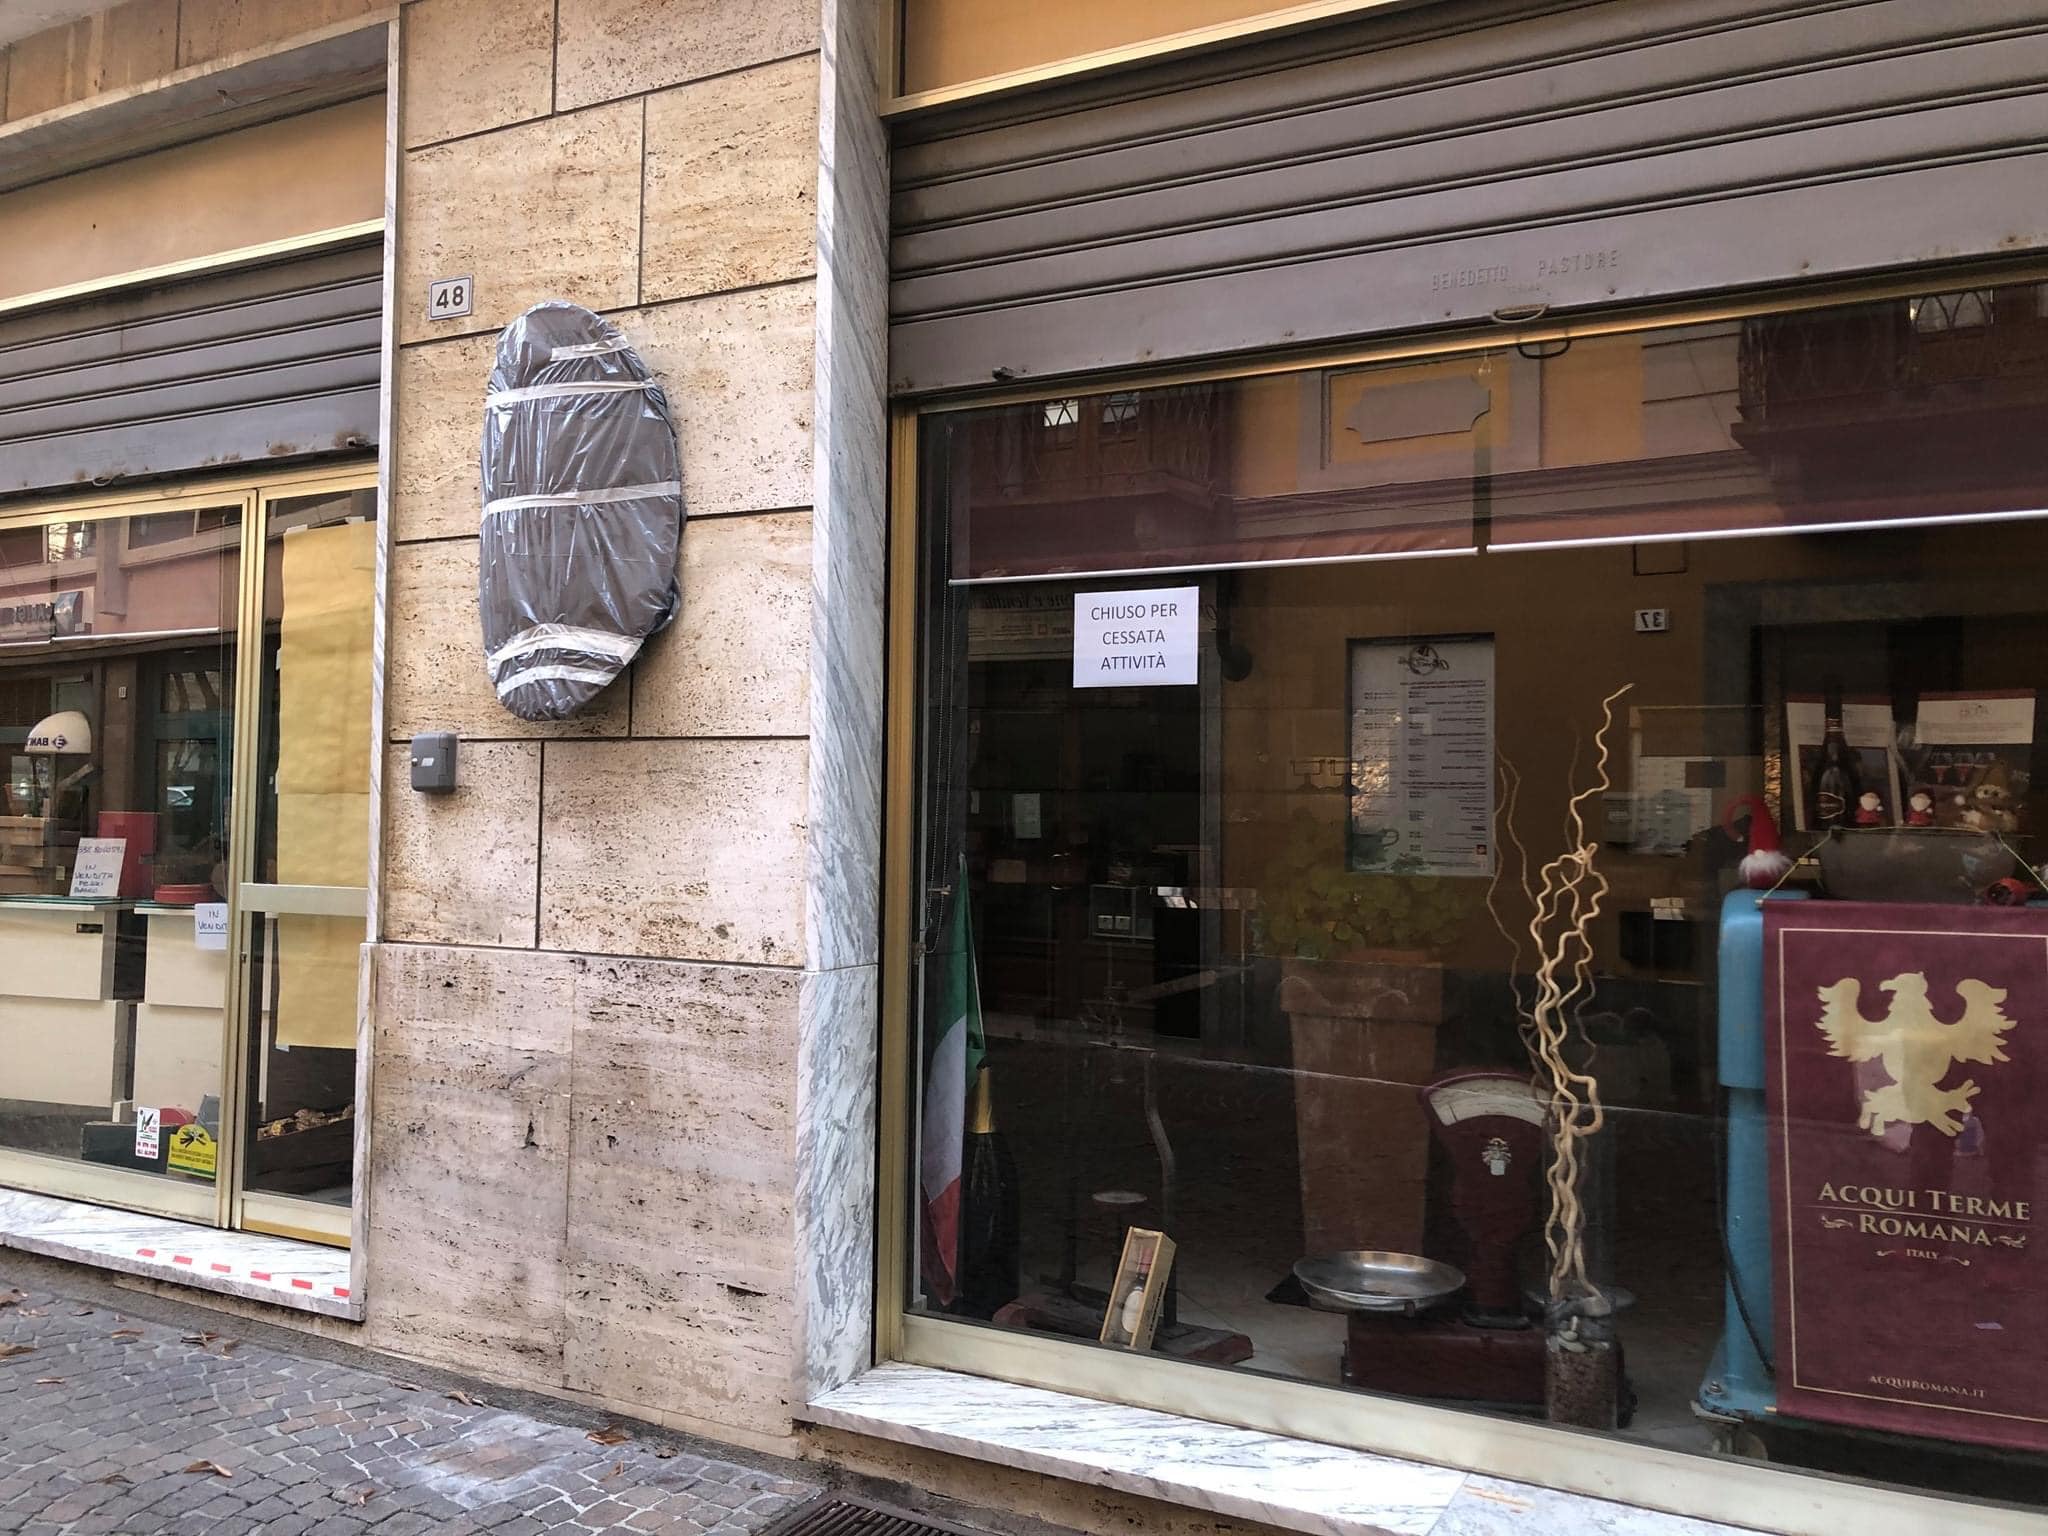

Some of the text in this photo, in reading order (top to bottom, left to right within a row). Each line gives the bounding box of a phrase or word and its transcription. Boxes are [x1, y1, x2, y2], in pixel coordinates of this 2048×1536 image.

[1431, 264, 1509, 291] BENEDETTO
[1538, 249, 1618, 278] PASTORE
[436, 285, 464, 309] 48
[1091, 603, 1178, 620] CHIUSO PER
[1102, 629, 1165, 645] CESSATA
[1100, 651, 1166, 670] ATTIVITÀ
[208, 910, 220, 919] IN
[1818, 1181, 2031, 1221] ACQUI TERME
[1859, 1213, 1993, 1246] ROMANA
[1906, 1248, 1940, 1261] ITALY
[1868, 1375, 1986, 1399] ACQUIROMANA.IT
